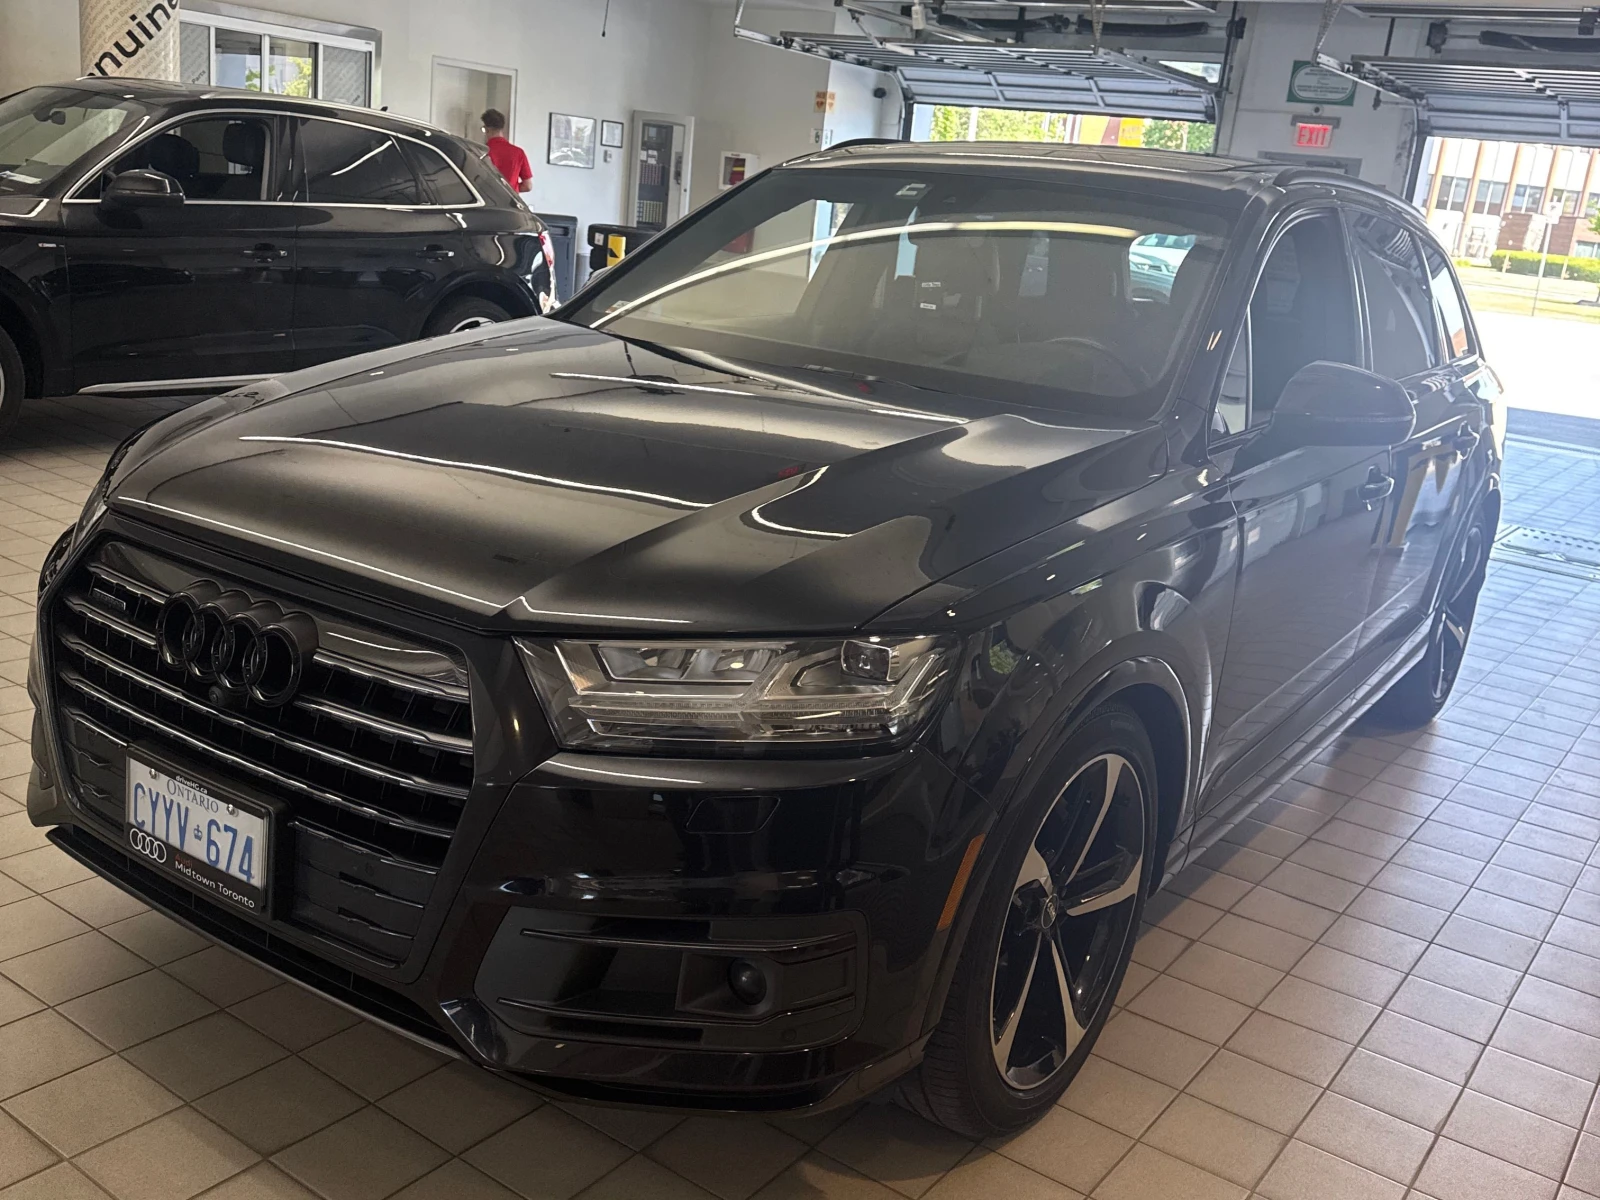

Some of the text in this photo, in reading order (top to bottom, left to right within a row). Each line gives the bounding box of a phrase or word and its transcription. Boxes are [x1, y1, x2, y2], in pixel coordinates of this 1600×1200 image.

[87, 0, 178, 76] nuin
[1297, 126, 1329, 146] EXIT
[167, 779, 219, 813] ONTARIO
[134, 782, 254, 882] CYYV 674
[175, 861, 255, 908] Midtown Toronto
